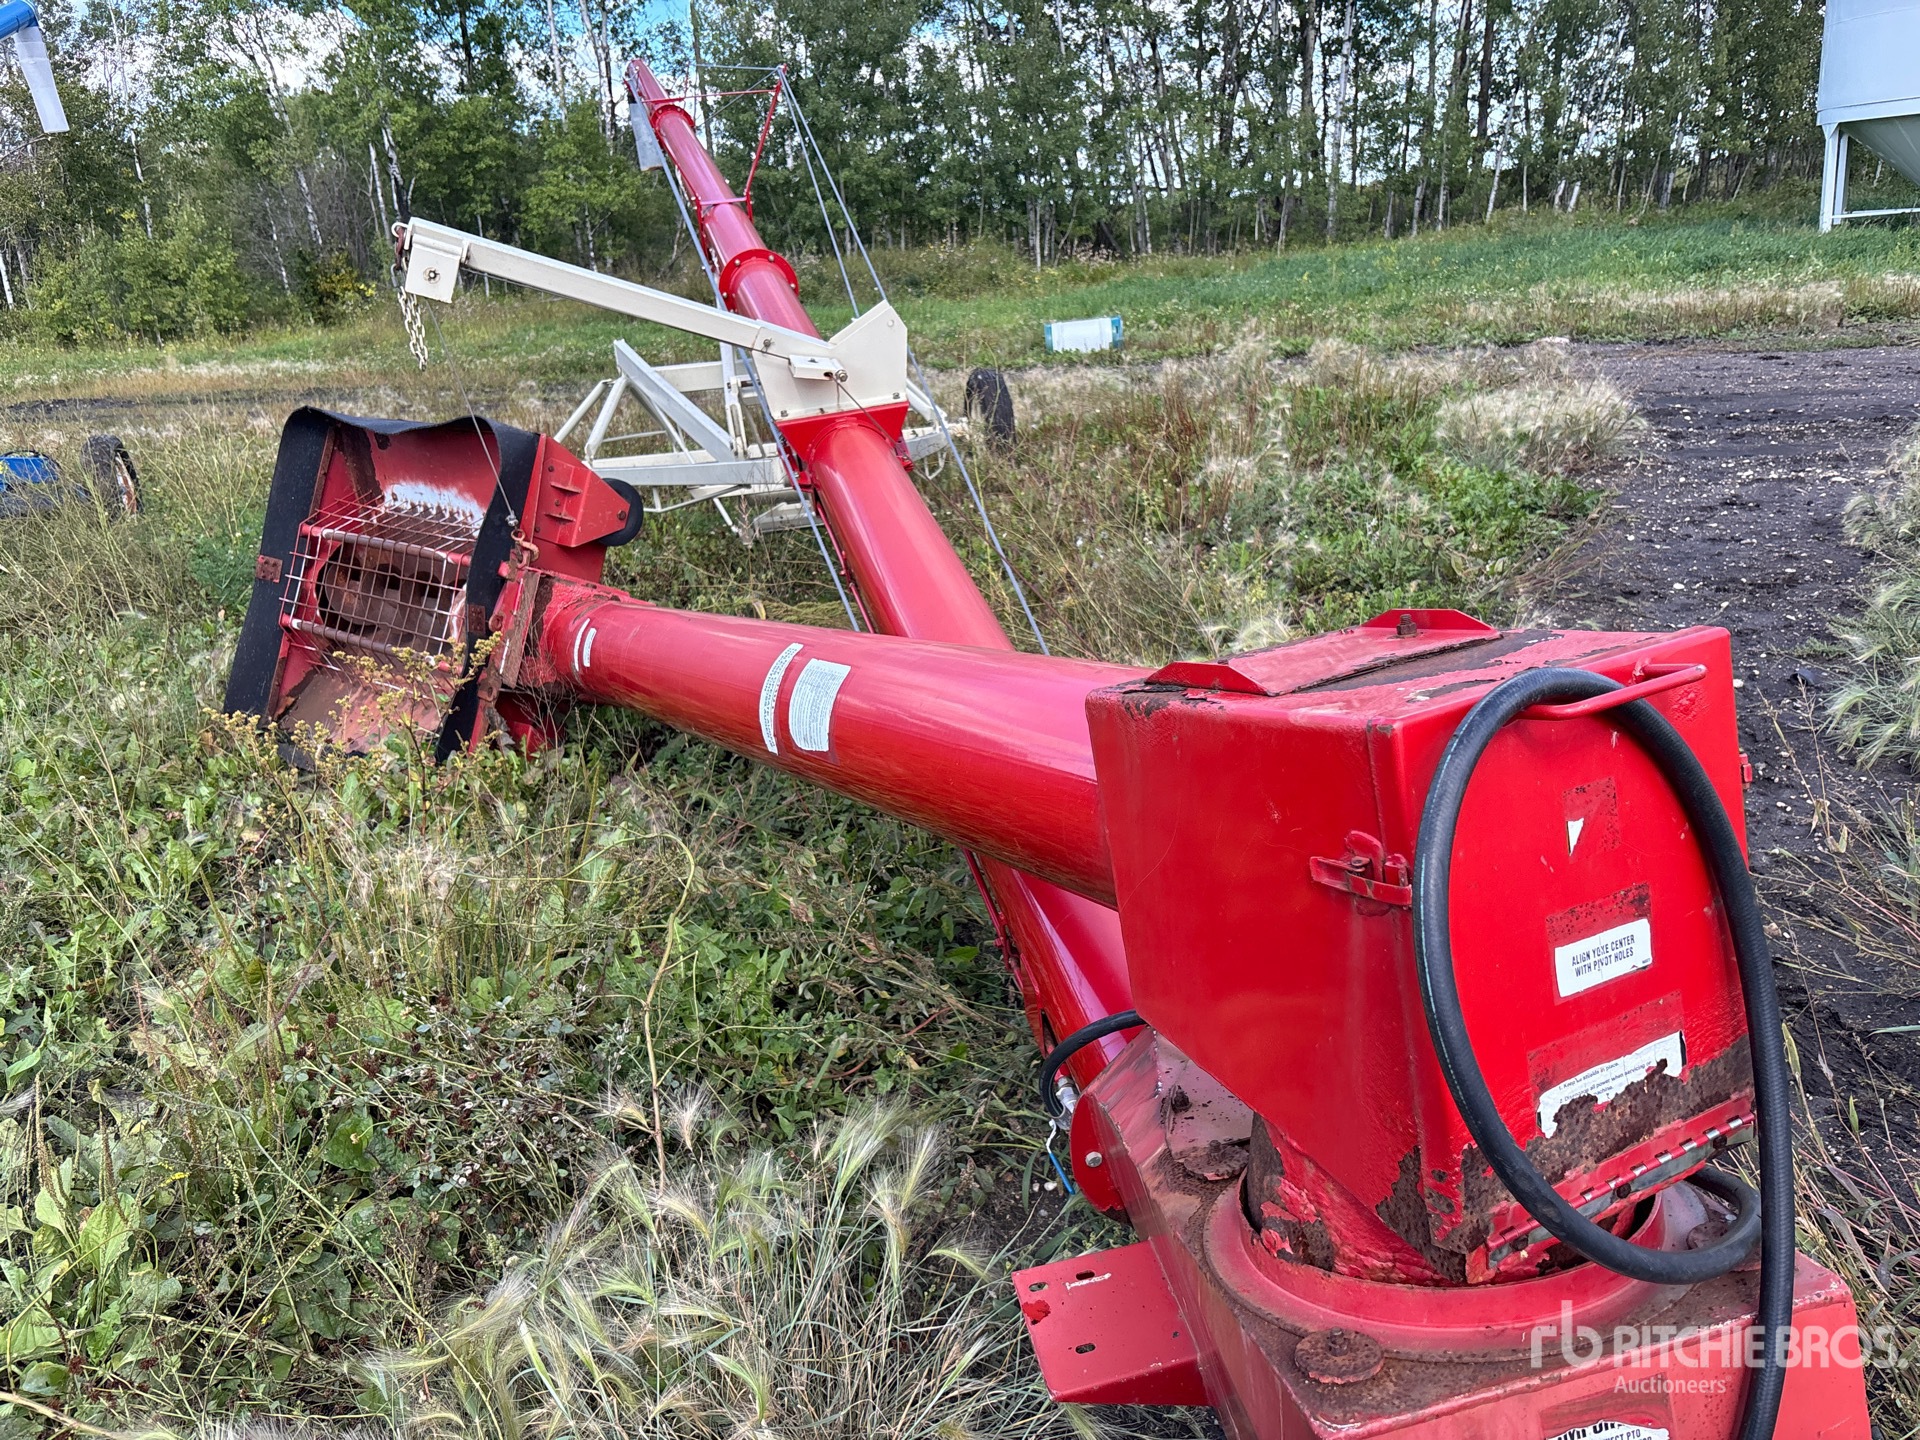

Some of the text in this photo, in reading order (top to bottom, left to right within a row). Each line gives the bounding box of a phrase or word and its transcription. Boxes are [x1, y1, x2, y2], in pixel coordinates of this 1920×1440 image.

[1572, 950, 1591, 966] ALIGN
[1610, 934, 1635, 951] CENTER
[1575, 962, 1592, 977] WITH
[1614, 946, 1634, 962] HOLES
[1596, 1079, 1610, 1089] power
[1611, 1073, 1624, 1081] when
[1624, 1063, 1646, 1076] servicing
